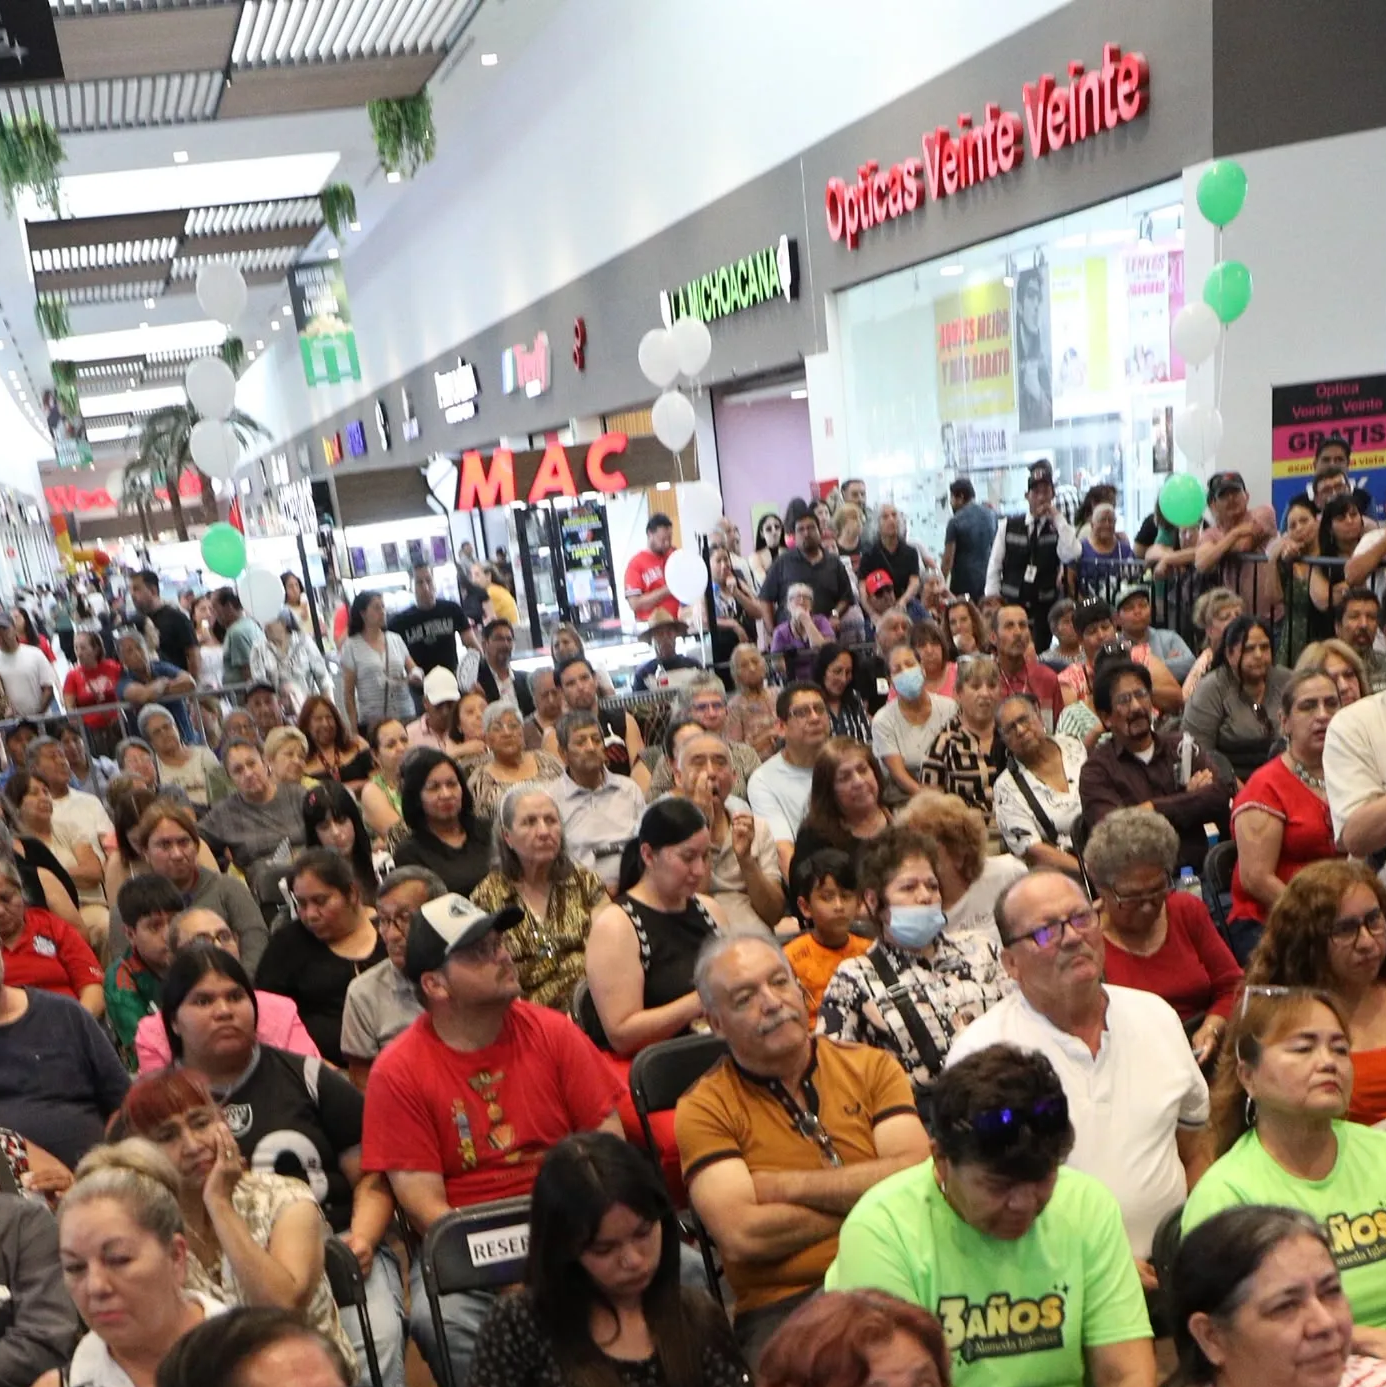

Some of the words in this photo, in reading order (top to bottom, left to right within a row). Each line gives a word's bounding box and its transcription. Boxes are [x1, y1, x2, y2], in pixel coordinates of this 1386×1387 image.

[922, 103, 1023, 200] Veinte
[1023, 41, 1150, 159] Veinte
[687, 245, 780, 322] MICHOACANA
[1292, 403, 1332, 419] Veinte
[1342, 397, 1383, 415] Veinte
[473, 1236, 530, 1261] RESER
